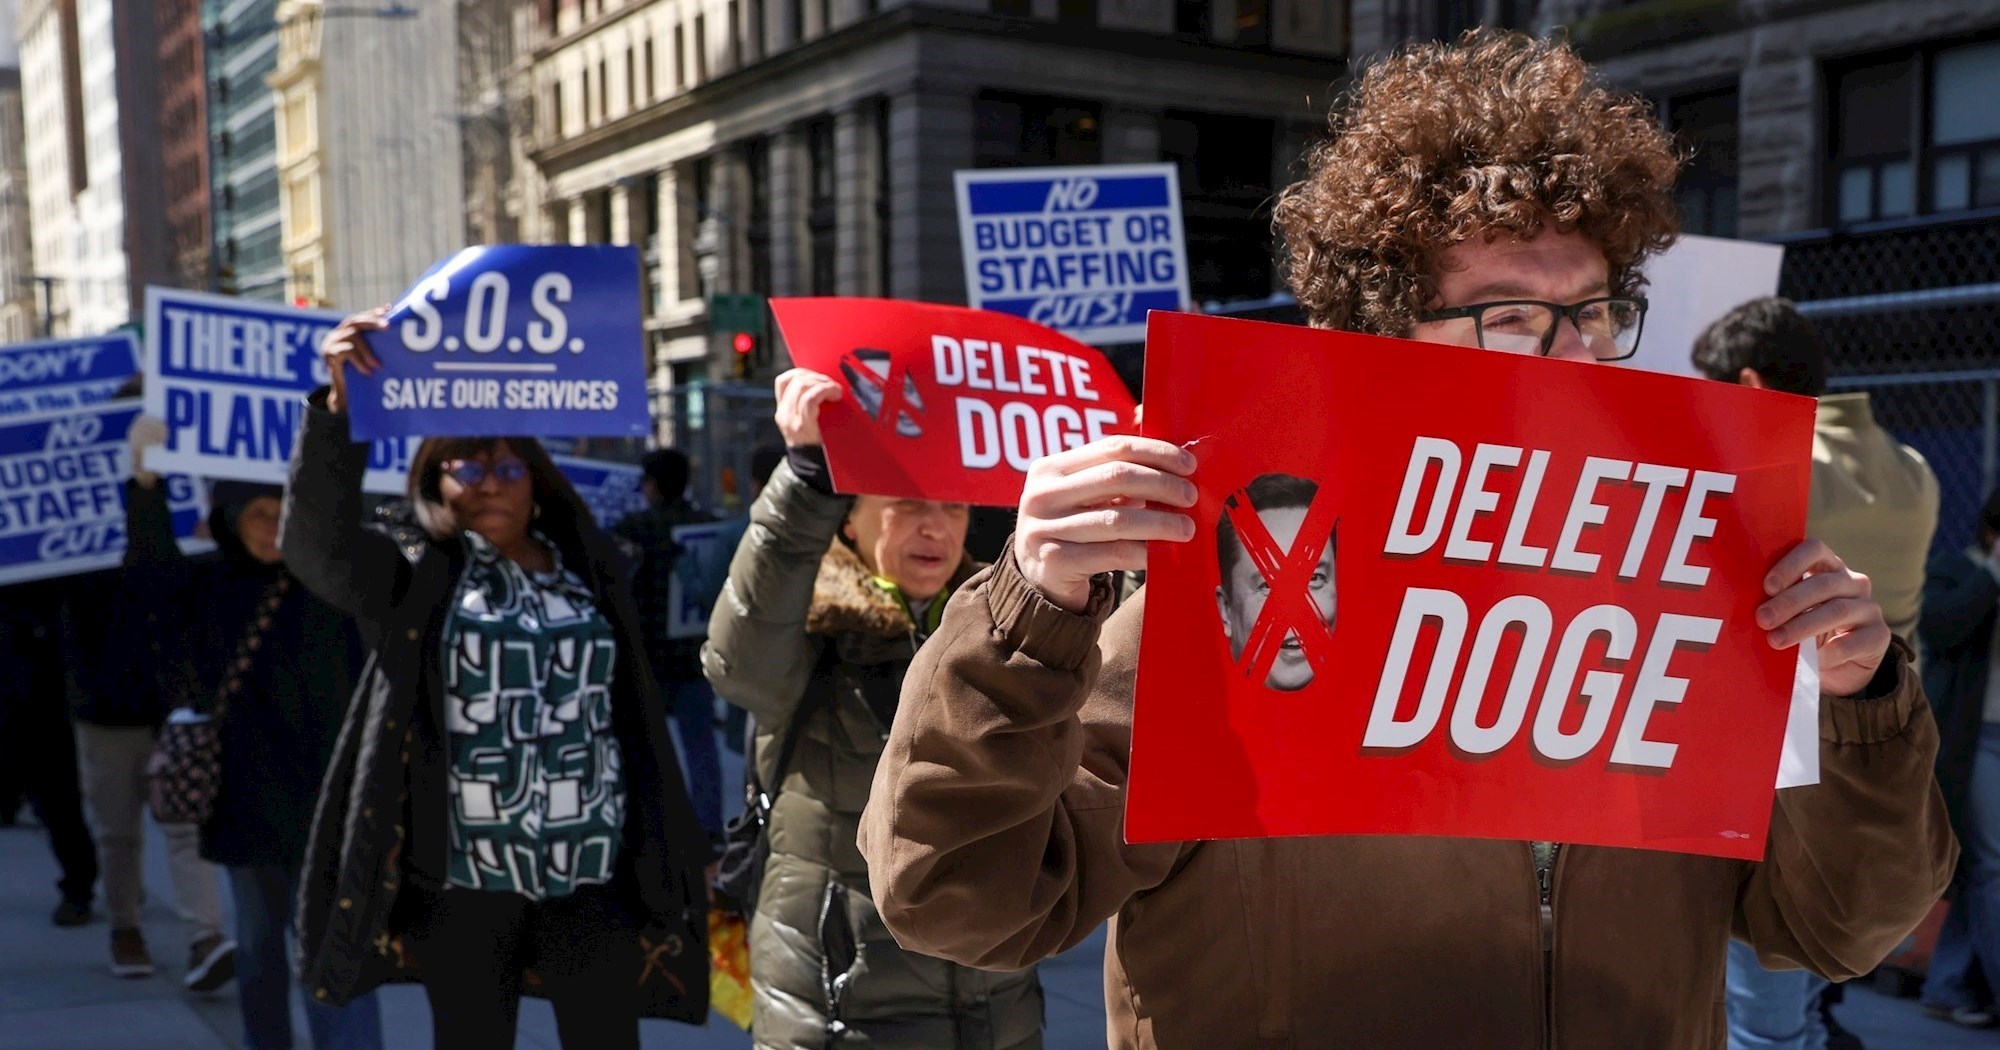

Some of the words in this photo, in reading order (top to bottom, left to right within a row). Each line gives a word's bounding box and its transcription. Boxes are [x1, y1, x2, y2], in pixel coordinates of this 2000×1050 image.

[1044, 179, 1099, 212] NO
[975, 216, 1111, 251] BUDGET
[1125, 213, 1171, 244] OR
[978, 249, 1176, 292] STAFFING
[400, 271, 586, 354] S.O.S.
[1028, 293, 1133, 327] CUTS!
[931, 334, 1099, 402] DELETE
[381, 378, 448, 411] SAVE
[451, 379, 501, 410] OUR
[504, 379, 619, 411] SERVICES
[44, 416, 103, 453] NO
[0, 448, 120, 489] UDGET
[1383, 435, 1737, 589] DELETE
[1362, 587, 1724, 772] DOGE
